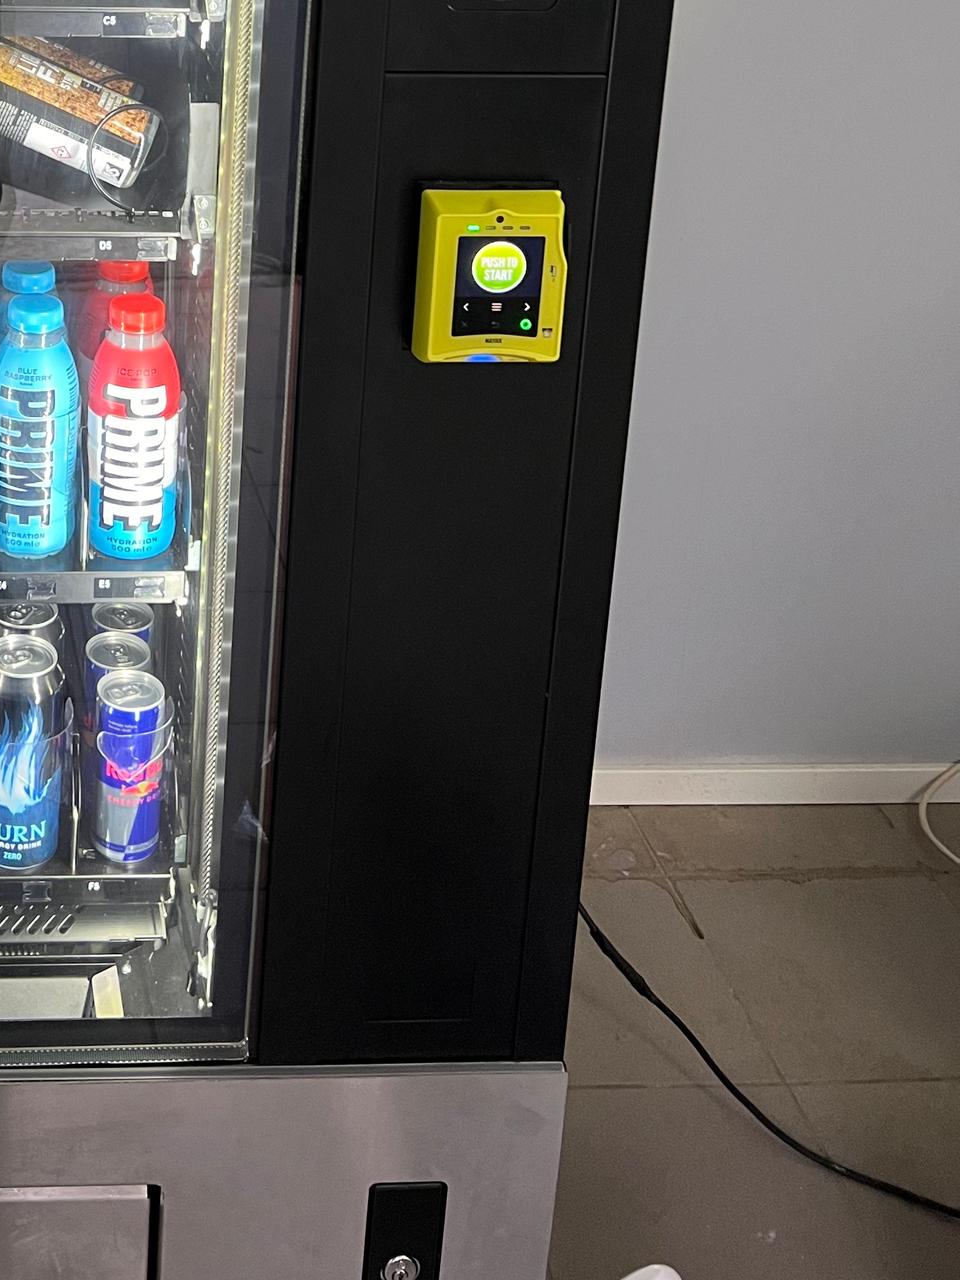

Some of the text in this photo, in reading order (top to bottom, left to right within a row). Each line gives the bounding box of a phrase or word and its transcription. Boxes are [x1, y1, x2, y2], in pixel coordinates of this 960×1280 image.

[103, 15, 116, 26] C5
[99, 240, 112, 250] D5
[481, 256, 505, 268] PUSH
[484, 269, 513, 281] START
[17, 367, 37, 375] BLUE
[97, 383, 168, 532] PRIME
[98, 578, 110, 589] E5
[17, 840, 42, 851] DRINK
[3, 851, 22, 861] ZERO
